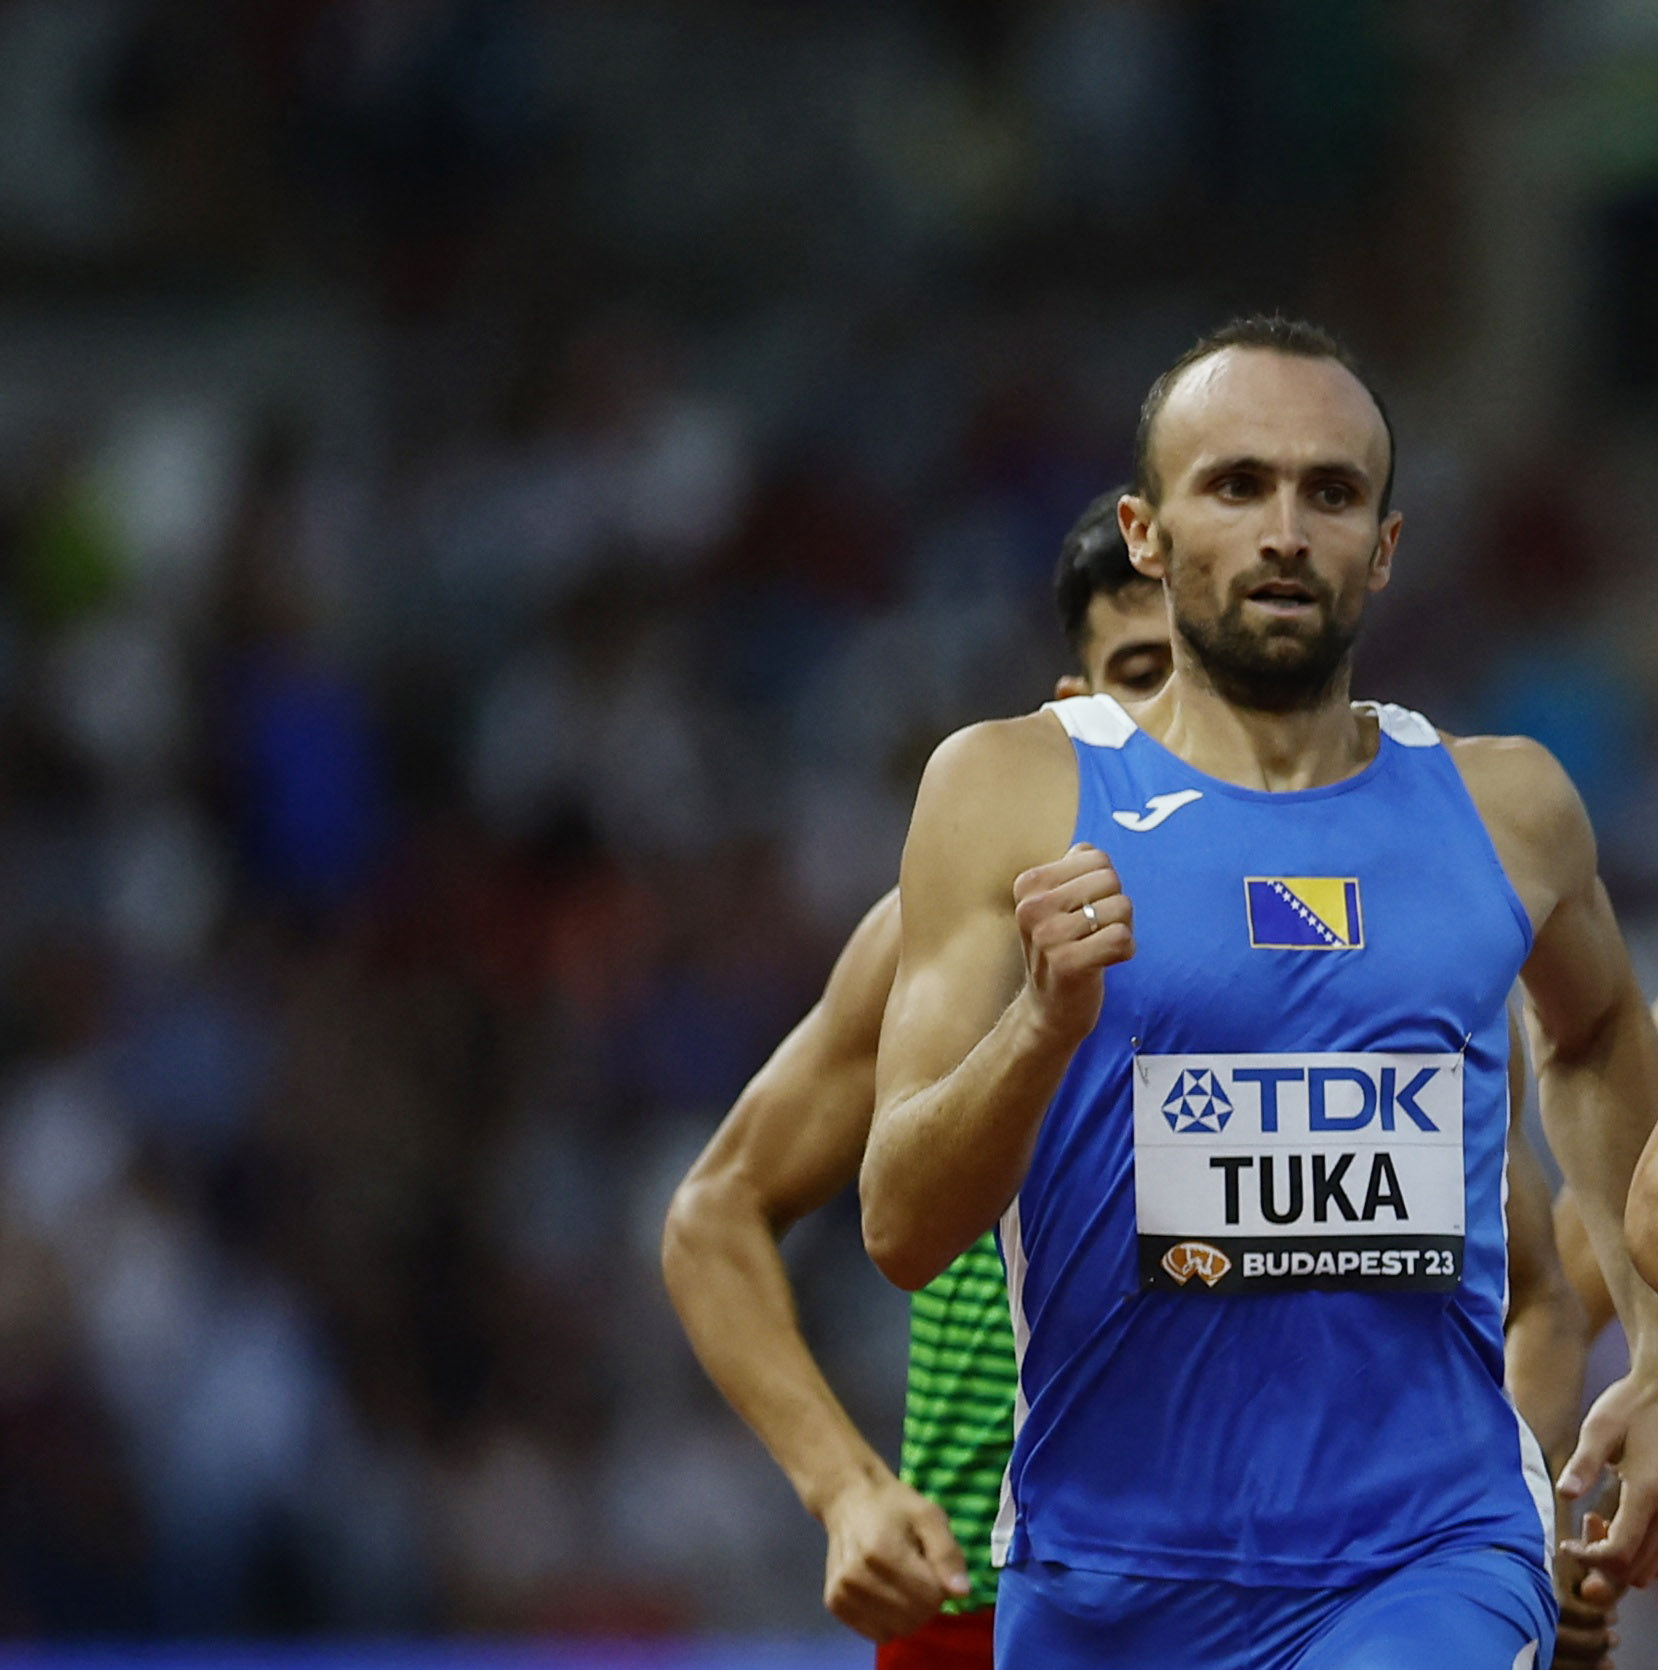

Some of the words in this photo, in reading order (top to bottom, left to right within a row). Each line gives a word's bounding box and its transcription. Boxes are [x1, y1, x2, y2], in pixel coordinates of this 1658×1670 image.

[1232, 1067, 1440, 1133] TDK
[1209, 1151, 1409, 1226] TUKA
[1242, 1250, 1420, 1278] BUDAPEST
[1424, 1249, 1455, 1275] 23
